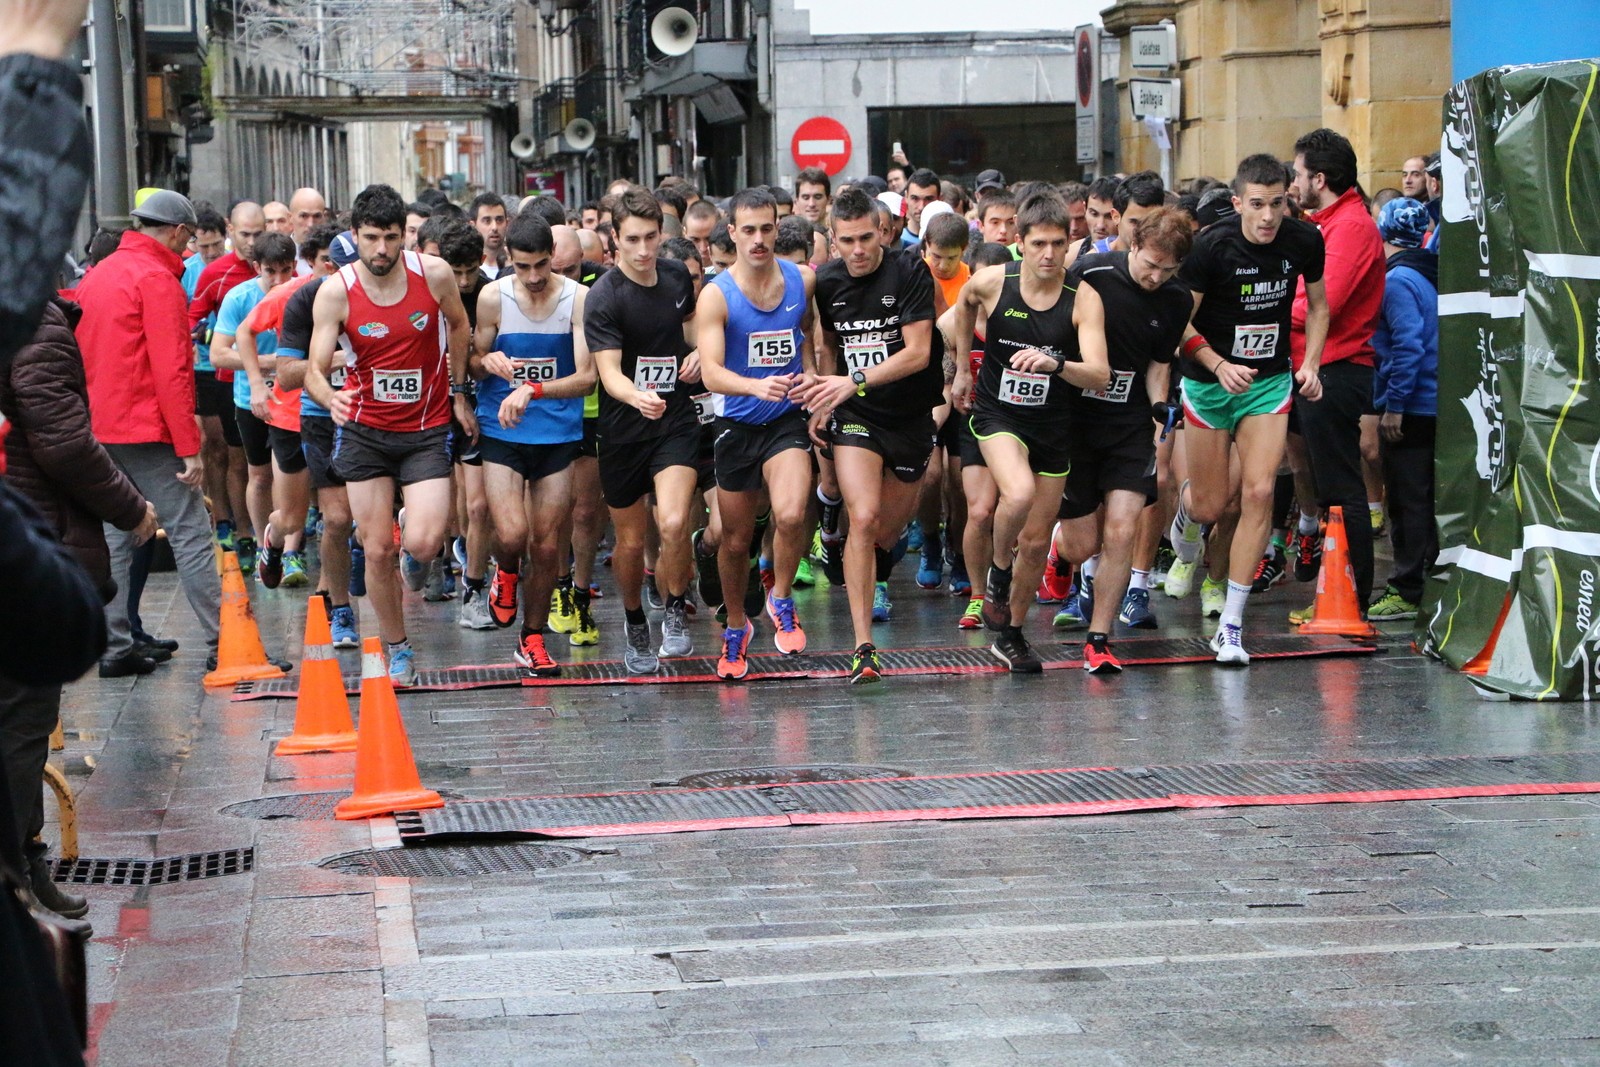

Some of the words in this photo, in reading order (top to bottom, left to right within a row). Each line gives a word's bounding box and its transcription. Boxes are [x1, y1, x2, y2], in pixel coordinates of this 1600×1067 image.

[1455, 81, 1490, 277] lacturale
[1254, 279, 1288, 295] MILAR
[1240, 289, 1287, 303] LARRAMENDI
[833, 315, 899, 331] BASQUE
[1012, 311, 1028, 319] asics
[753, 340, 792, 357] 155
[1239, 333, 1275, 349] 172
[848, 351, 885, 368] 170
[513, 366, 553, 380] 260
[640, 366, 675, 382] 177
[377, 378, 418, 392] 148
[1005, 380, 1045, 397] 186
[1576, 569, 1594, 633] esnea
